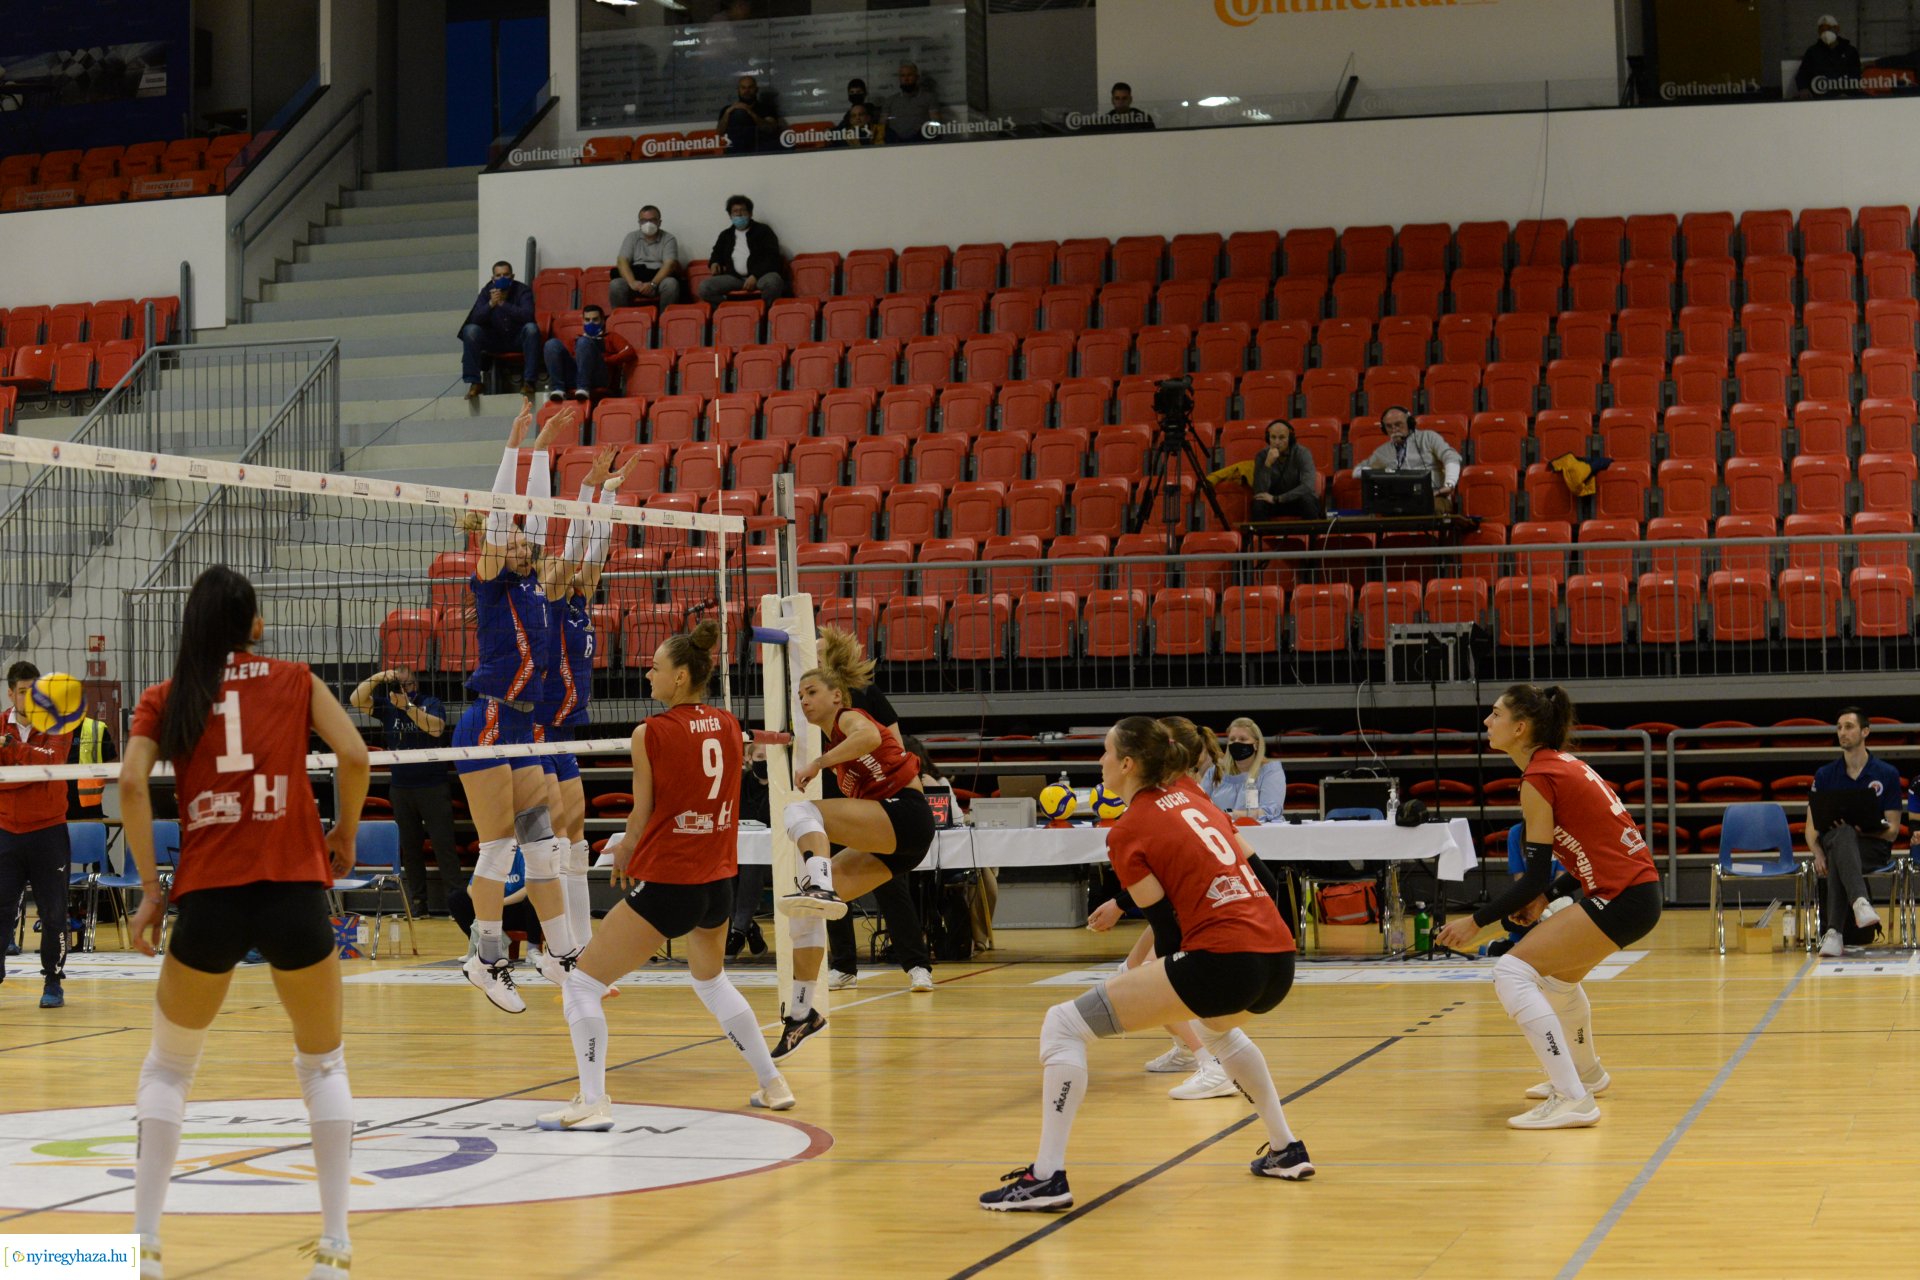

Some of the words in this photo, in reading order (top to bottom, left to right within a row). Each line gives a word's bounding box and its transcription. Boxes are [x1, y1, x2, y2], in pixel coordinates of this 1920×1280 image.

[1660, 79, 1746, 101] Continental
[1811, 73, 1898, 95] Continental
[921, 117, 1004, 139] Continental
[1066, 110, 1149, 131] Continental
[642, 134, 720, 157] Continental
[780, 126, 860, 148] Continental
[509, 144, 584, 166] Continental
[224, 662, 270, 682] ILEVA
[212, 690, 254, 774] 1
[689, 715, 722, 734] PINTÉR
[701, 738, 724, 800] 9
[1154, 791, 1190, 812] FUCHS
[1180, 807, 1237, 866] 6
